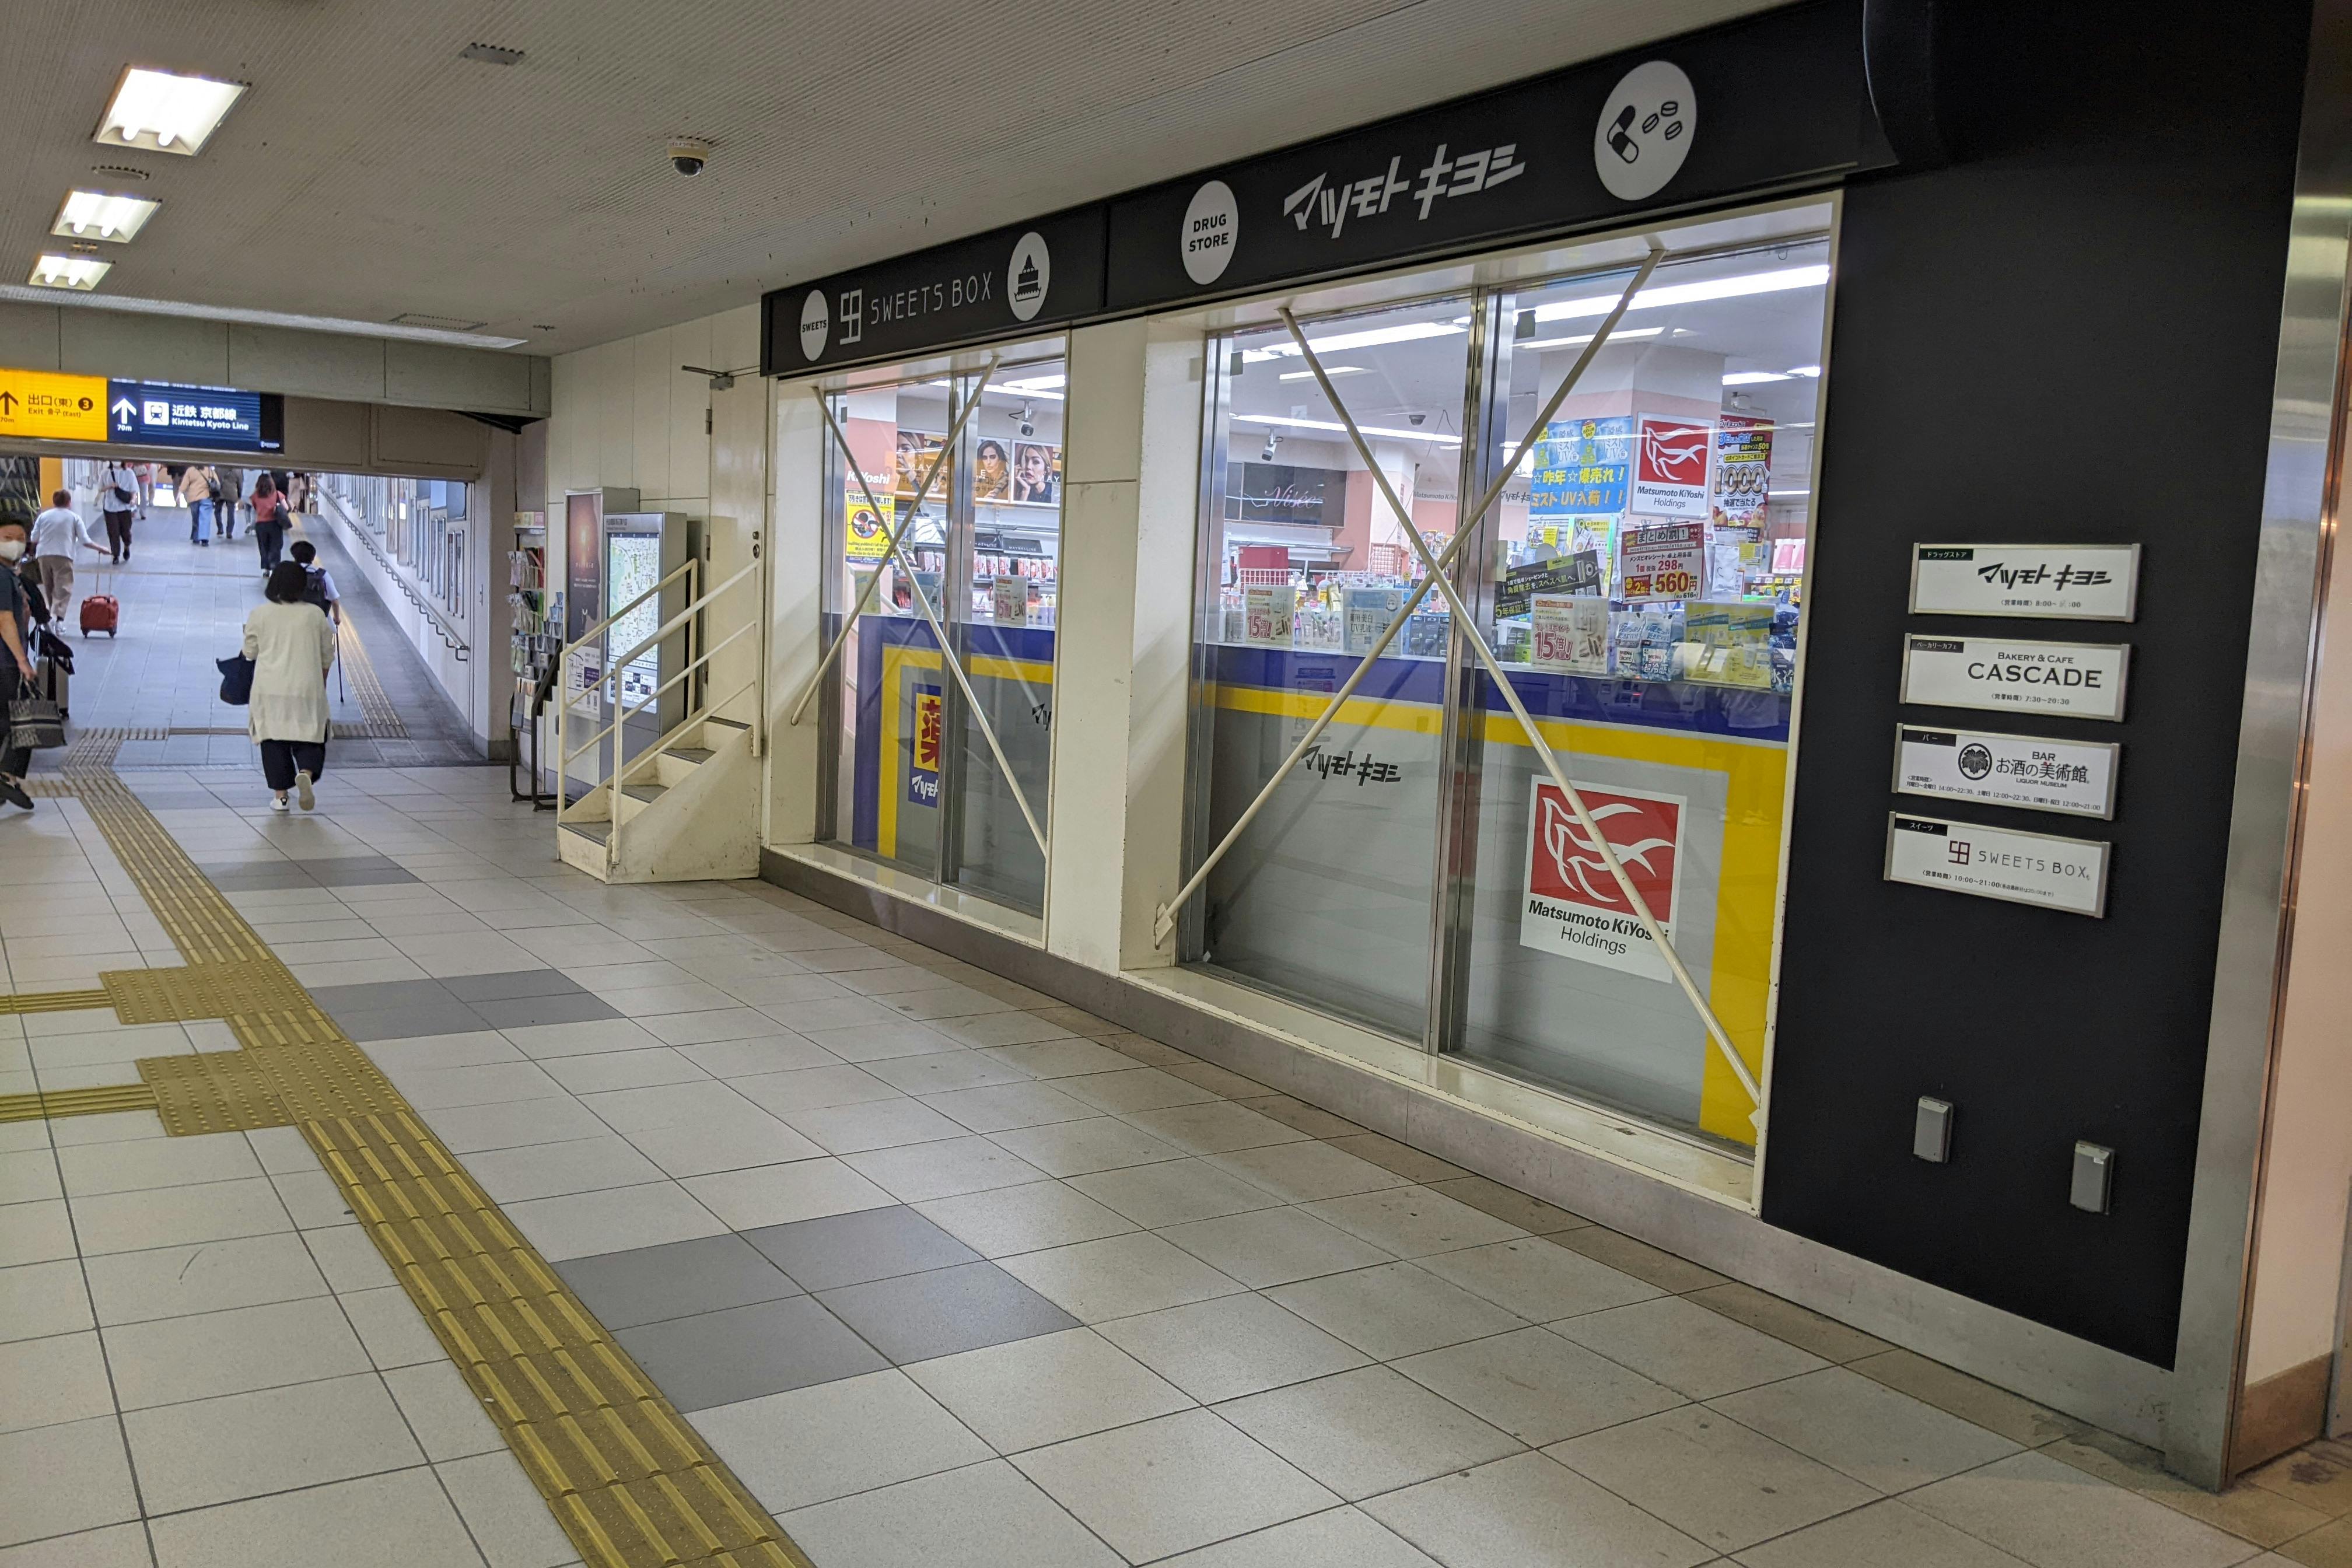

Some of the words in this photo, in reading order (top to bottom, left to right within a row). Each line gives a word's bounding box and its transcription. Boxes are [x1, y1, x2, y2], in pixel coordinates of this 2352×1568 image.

[1283, 144, 1525, 238] マツモトキヨシ
[1193, 214, 1227, 233] DRUG
[1189, 233, 1229, 253] STORE
[871, 284, 943, 324] SWEETS
[952, 271, 992, 308] BOX
[802, 319, 827, 332] SWEETS
[82, 399, 89, 409] 3
[172, 404, 197, 418] 近鉄
[200, 406, 237, 421] 京都線
[117, 424, 132, 432] 70m
[172, 418, 205, 428] Kintetsu
[206, 420, 231, 430] Kyoto
[232, 421, 249, 430] Line
[1637, 486, 1678, 497] Matsumoto
[1679, 489, 1704, 499] KiYoshi
[1653, 498, 1686, 509] Holdings
[1978, 562, 2112, 592] マツモトキヨシ
[1916, 642, 1957, 650] ベーカリーカフェ
[1998, 652, 2035, 663] BAKERY
[2037, 654, 2045, 663] &
[2047, 654, 2074, 664] CAFE
[1968, 662, 2102, 689] CASCADE
[1301, 744, 1401, 786] マツモトキヨシ
[2032, 751, 2056, 761] BAR
[1996, 758, 2089, 784] お酒の美術館
[1909, 821, 1934, 831] スイーツ
[1978, 850, 2045, 872] SWEETS
[2052, 862, 2087, 878] BOX
[1528, 900, 1610, 930] Matsumoto
[1560, 926, 1626, 956] Holdings
